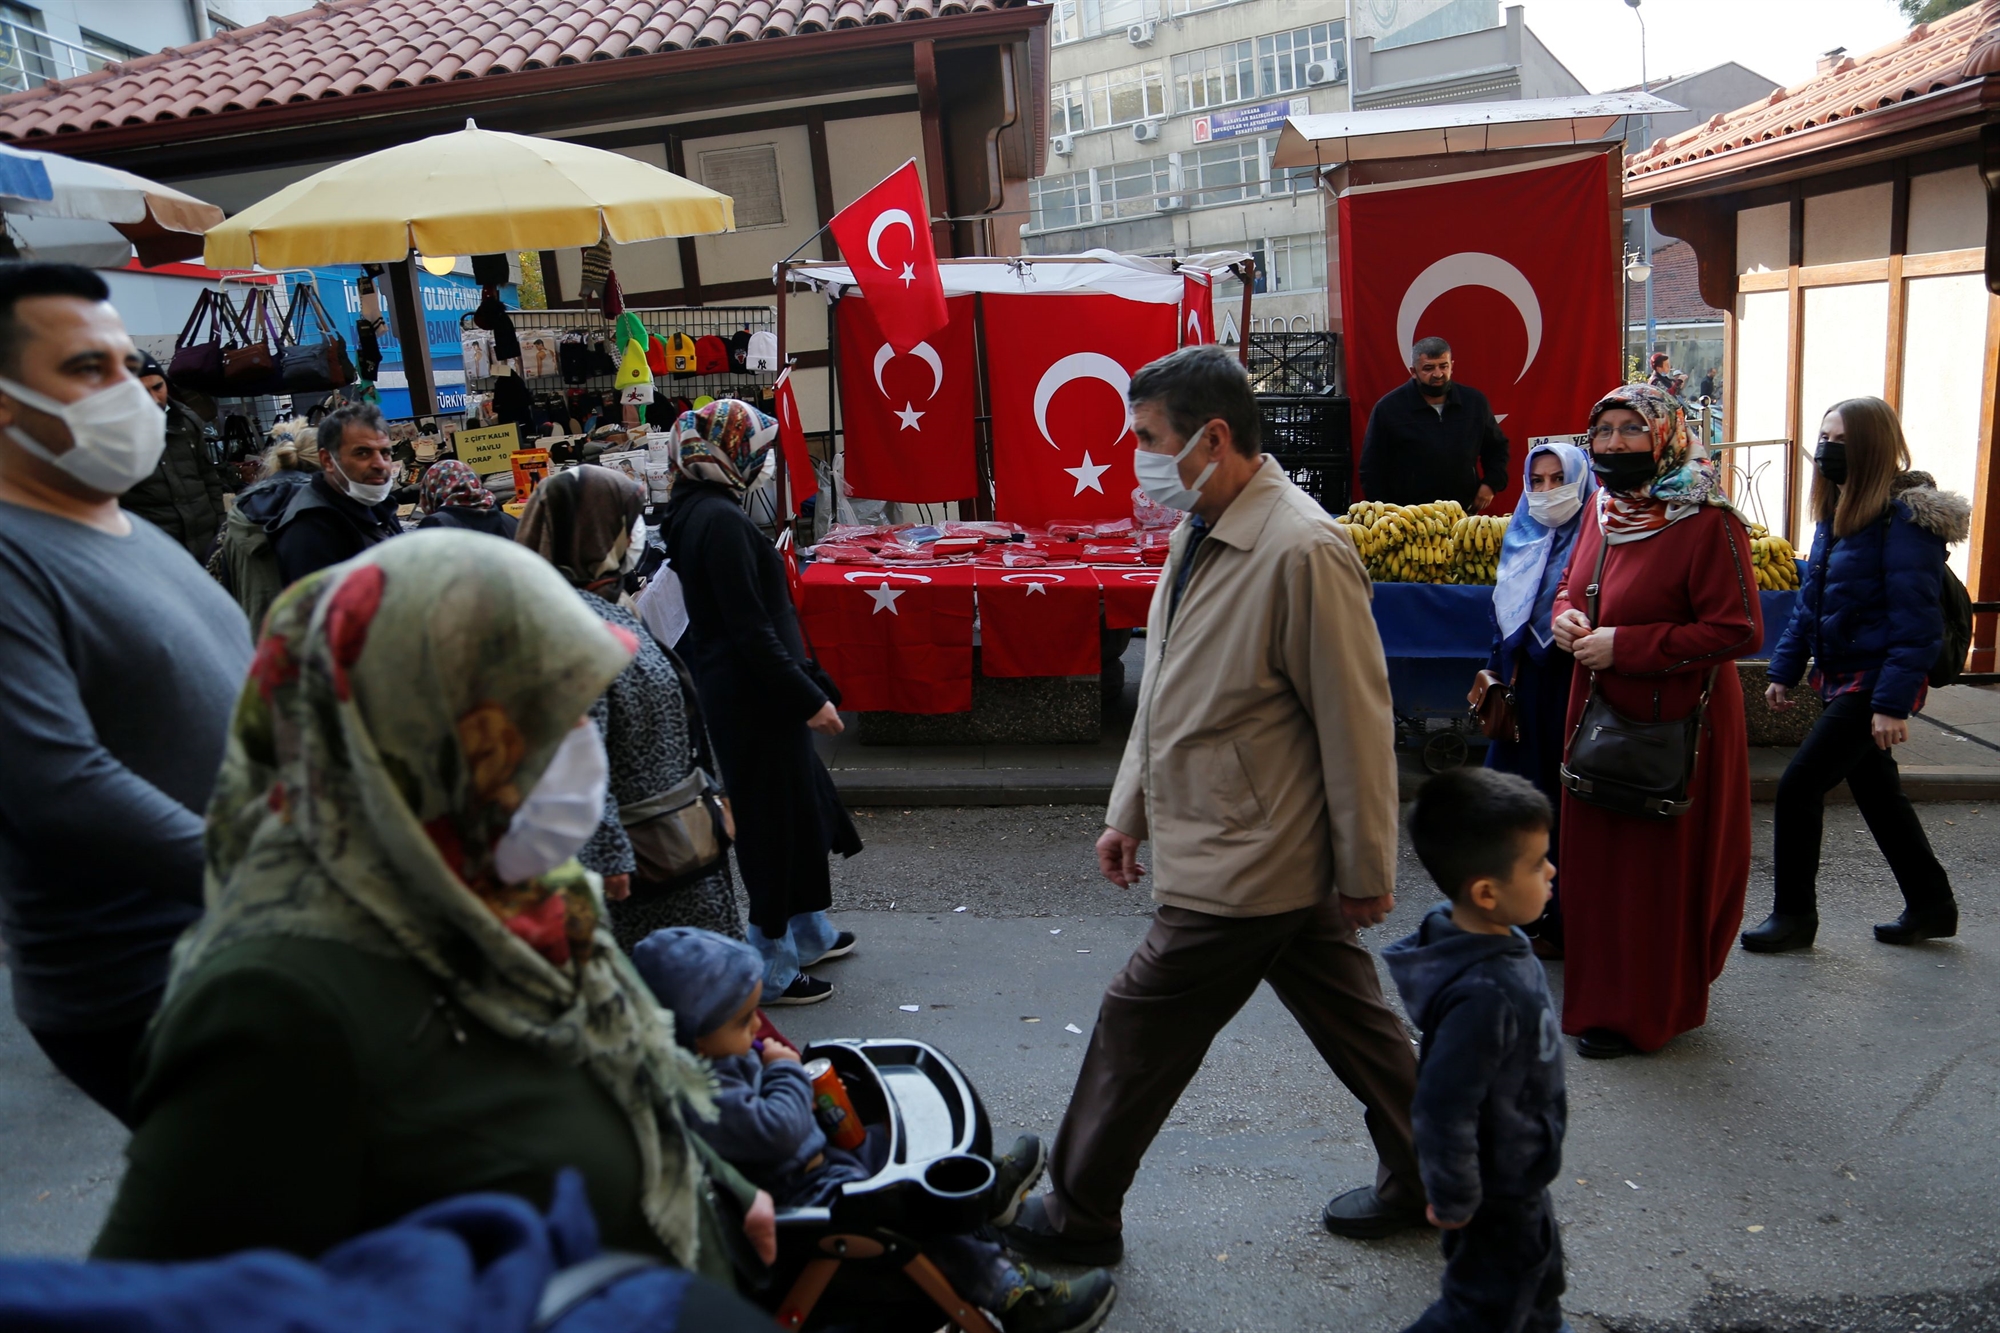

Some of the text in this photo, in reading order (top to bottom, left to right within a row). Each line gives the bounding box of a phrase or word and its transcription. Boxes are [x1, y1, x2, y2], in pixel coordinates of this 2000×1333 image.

[1241, 108, 1260, 116] ANKARA
[427, 321, 461, 345] BANK
[470, 434, 487, 444] ÇİFT
[488, 431, 510, 440] KALIN
[476, 443, 501, 452] HAVLU
[466, 455, 492, 465] ÇORAP
